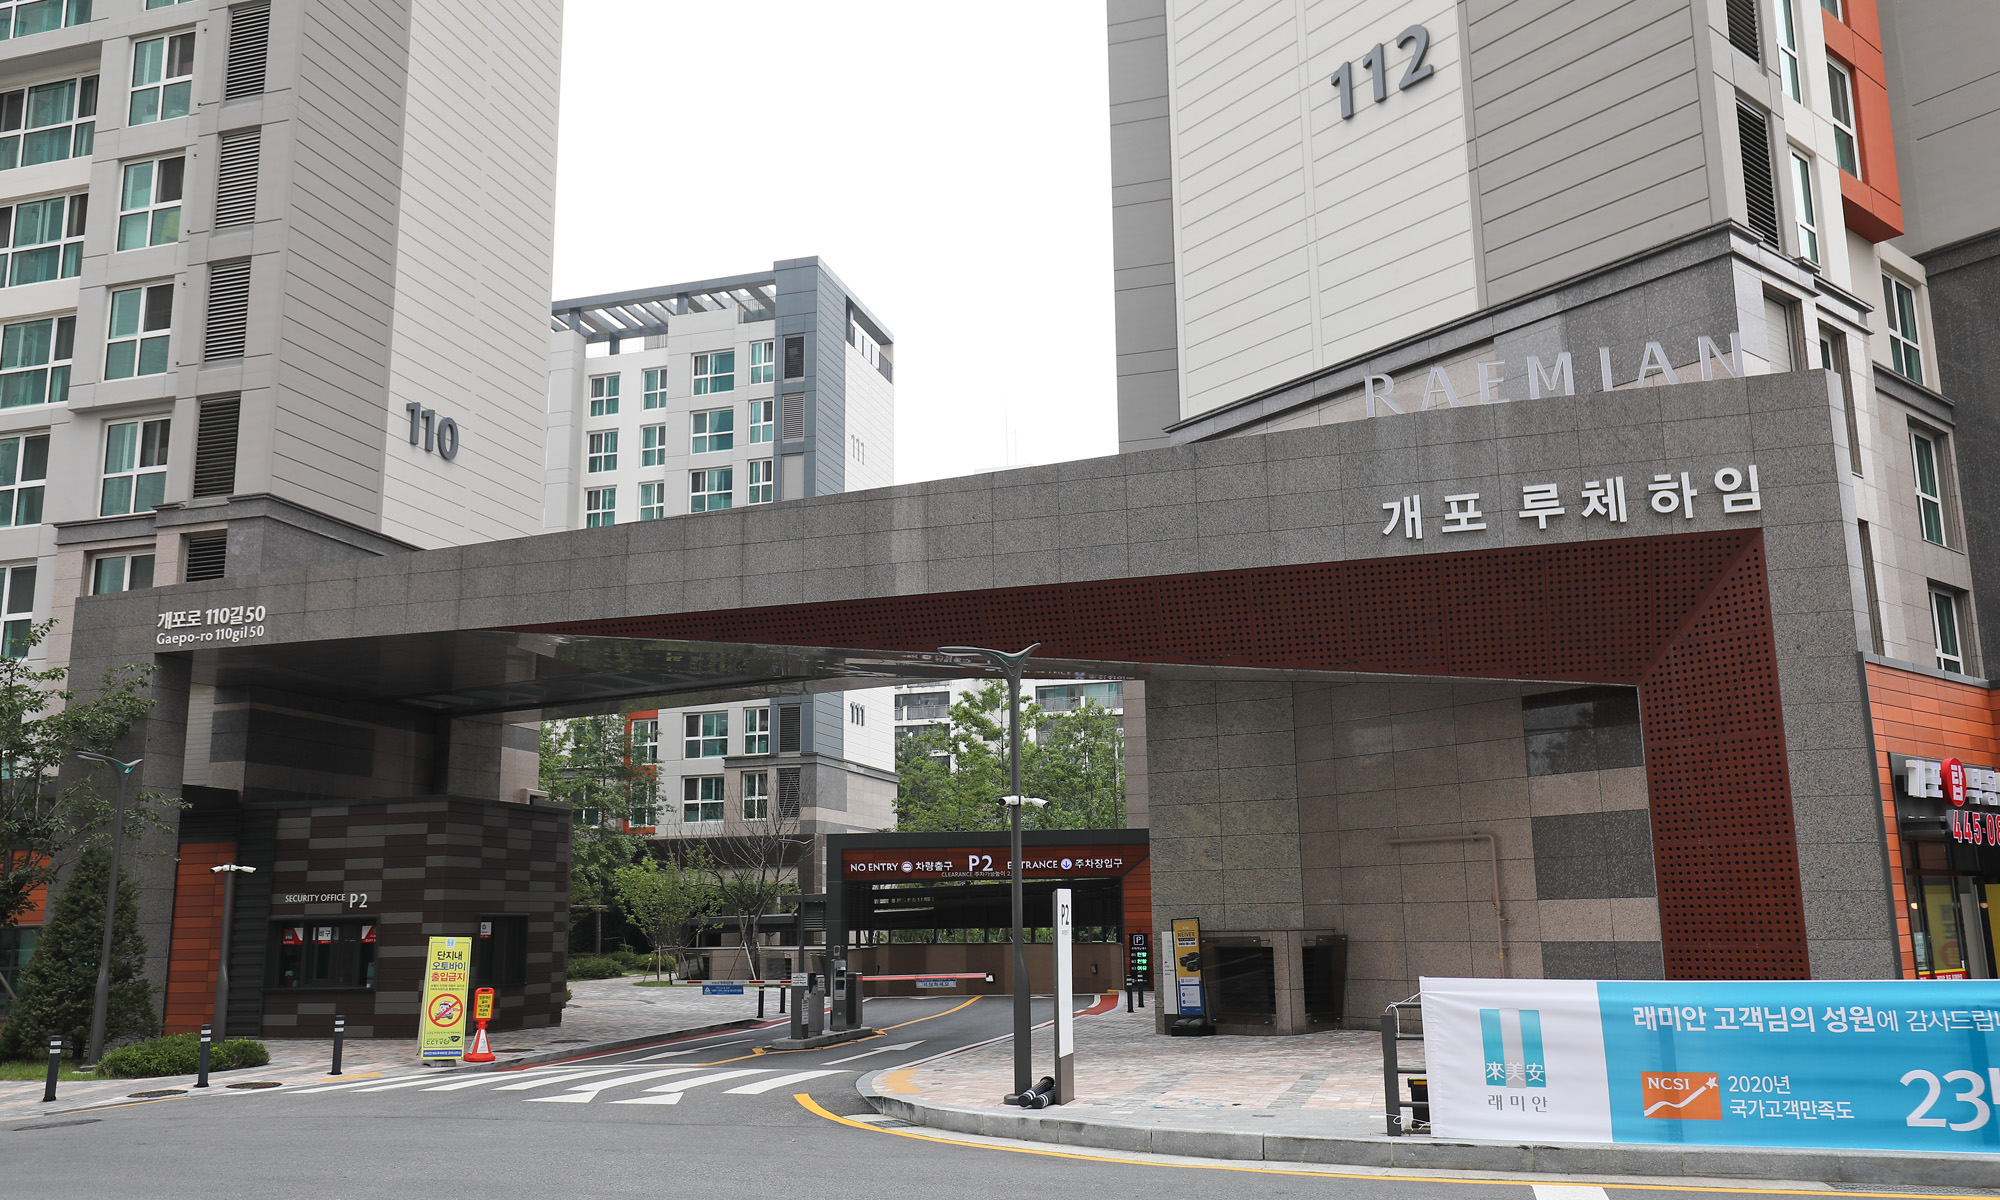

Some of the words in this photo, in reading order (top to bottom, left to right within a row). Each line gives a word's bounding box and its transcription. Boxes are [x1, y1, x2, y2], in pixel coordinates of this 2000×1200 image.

[1331, 24, 1434, 120] 112
[1364, 332, 1745, 418] RAEMIAN
[406, 402, 459, 460] 110
[850, 434, 865, 465] 111
[1382, 492, 1487, 539] 개포
[1519, 464, 1762, 529] 루체하임
[157, 611, 201, 630] 개포로
[205, 606, 244, 625] 110길
[245, 605, 266, 623] 50
[156, 633, 213, 647] Gaepo-ro
[215, 625, 248, 643] 110gil
[249, 625, 265, 638] 50
[850, 701, 865, 727] 111
[850, 863, 866, 872] NO
[868, 862, 899, 872] ENTRY
[915, 861, 953, 872] 차량출구
[968, 854, 994, 872] P2
[1007, 859, 1058, 870] ETRANCE
[1075, 858, 1123, 869] 주차장입구
[285, 894, 320, 903] SECURITY
[320, 893, 346, 902] OFFICE
[349, 893, 368, 908] P2
[1061, 904, 1070, 926] P2
[432, 961, 466, 971] 오토바이
[437, 951, 463, 960] 단지내
[431, 972, 466, 982] 출입금지
[1633, 1006, 1707, 1032] 래미안
[1714, 1006, 1816, 1033] 고객님의
[1822, 1006, 1899, 1032] 성원에
[1486, 1061, 1545, 1082] 來美安
[1647, 1076, 1691, 1091] NCSI
[1727, 1075, 1791, 1095] 2020년
[1487, 1094, 1548, 1113] 래미안
[1730, 1099, 1855, 1121] 국가고객만족도
[1899, 1067, 2000, 1132] 23
